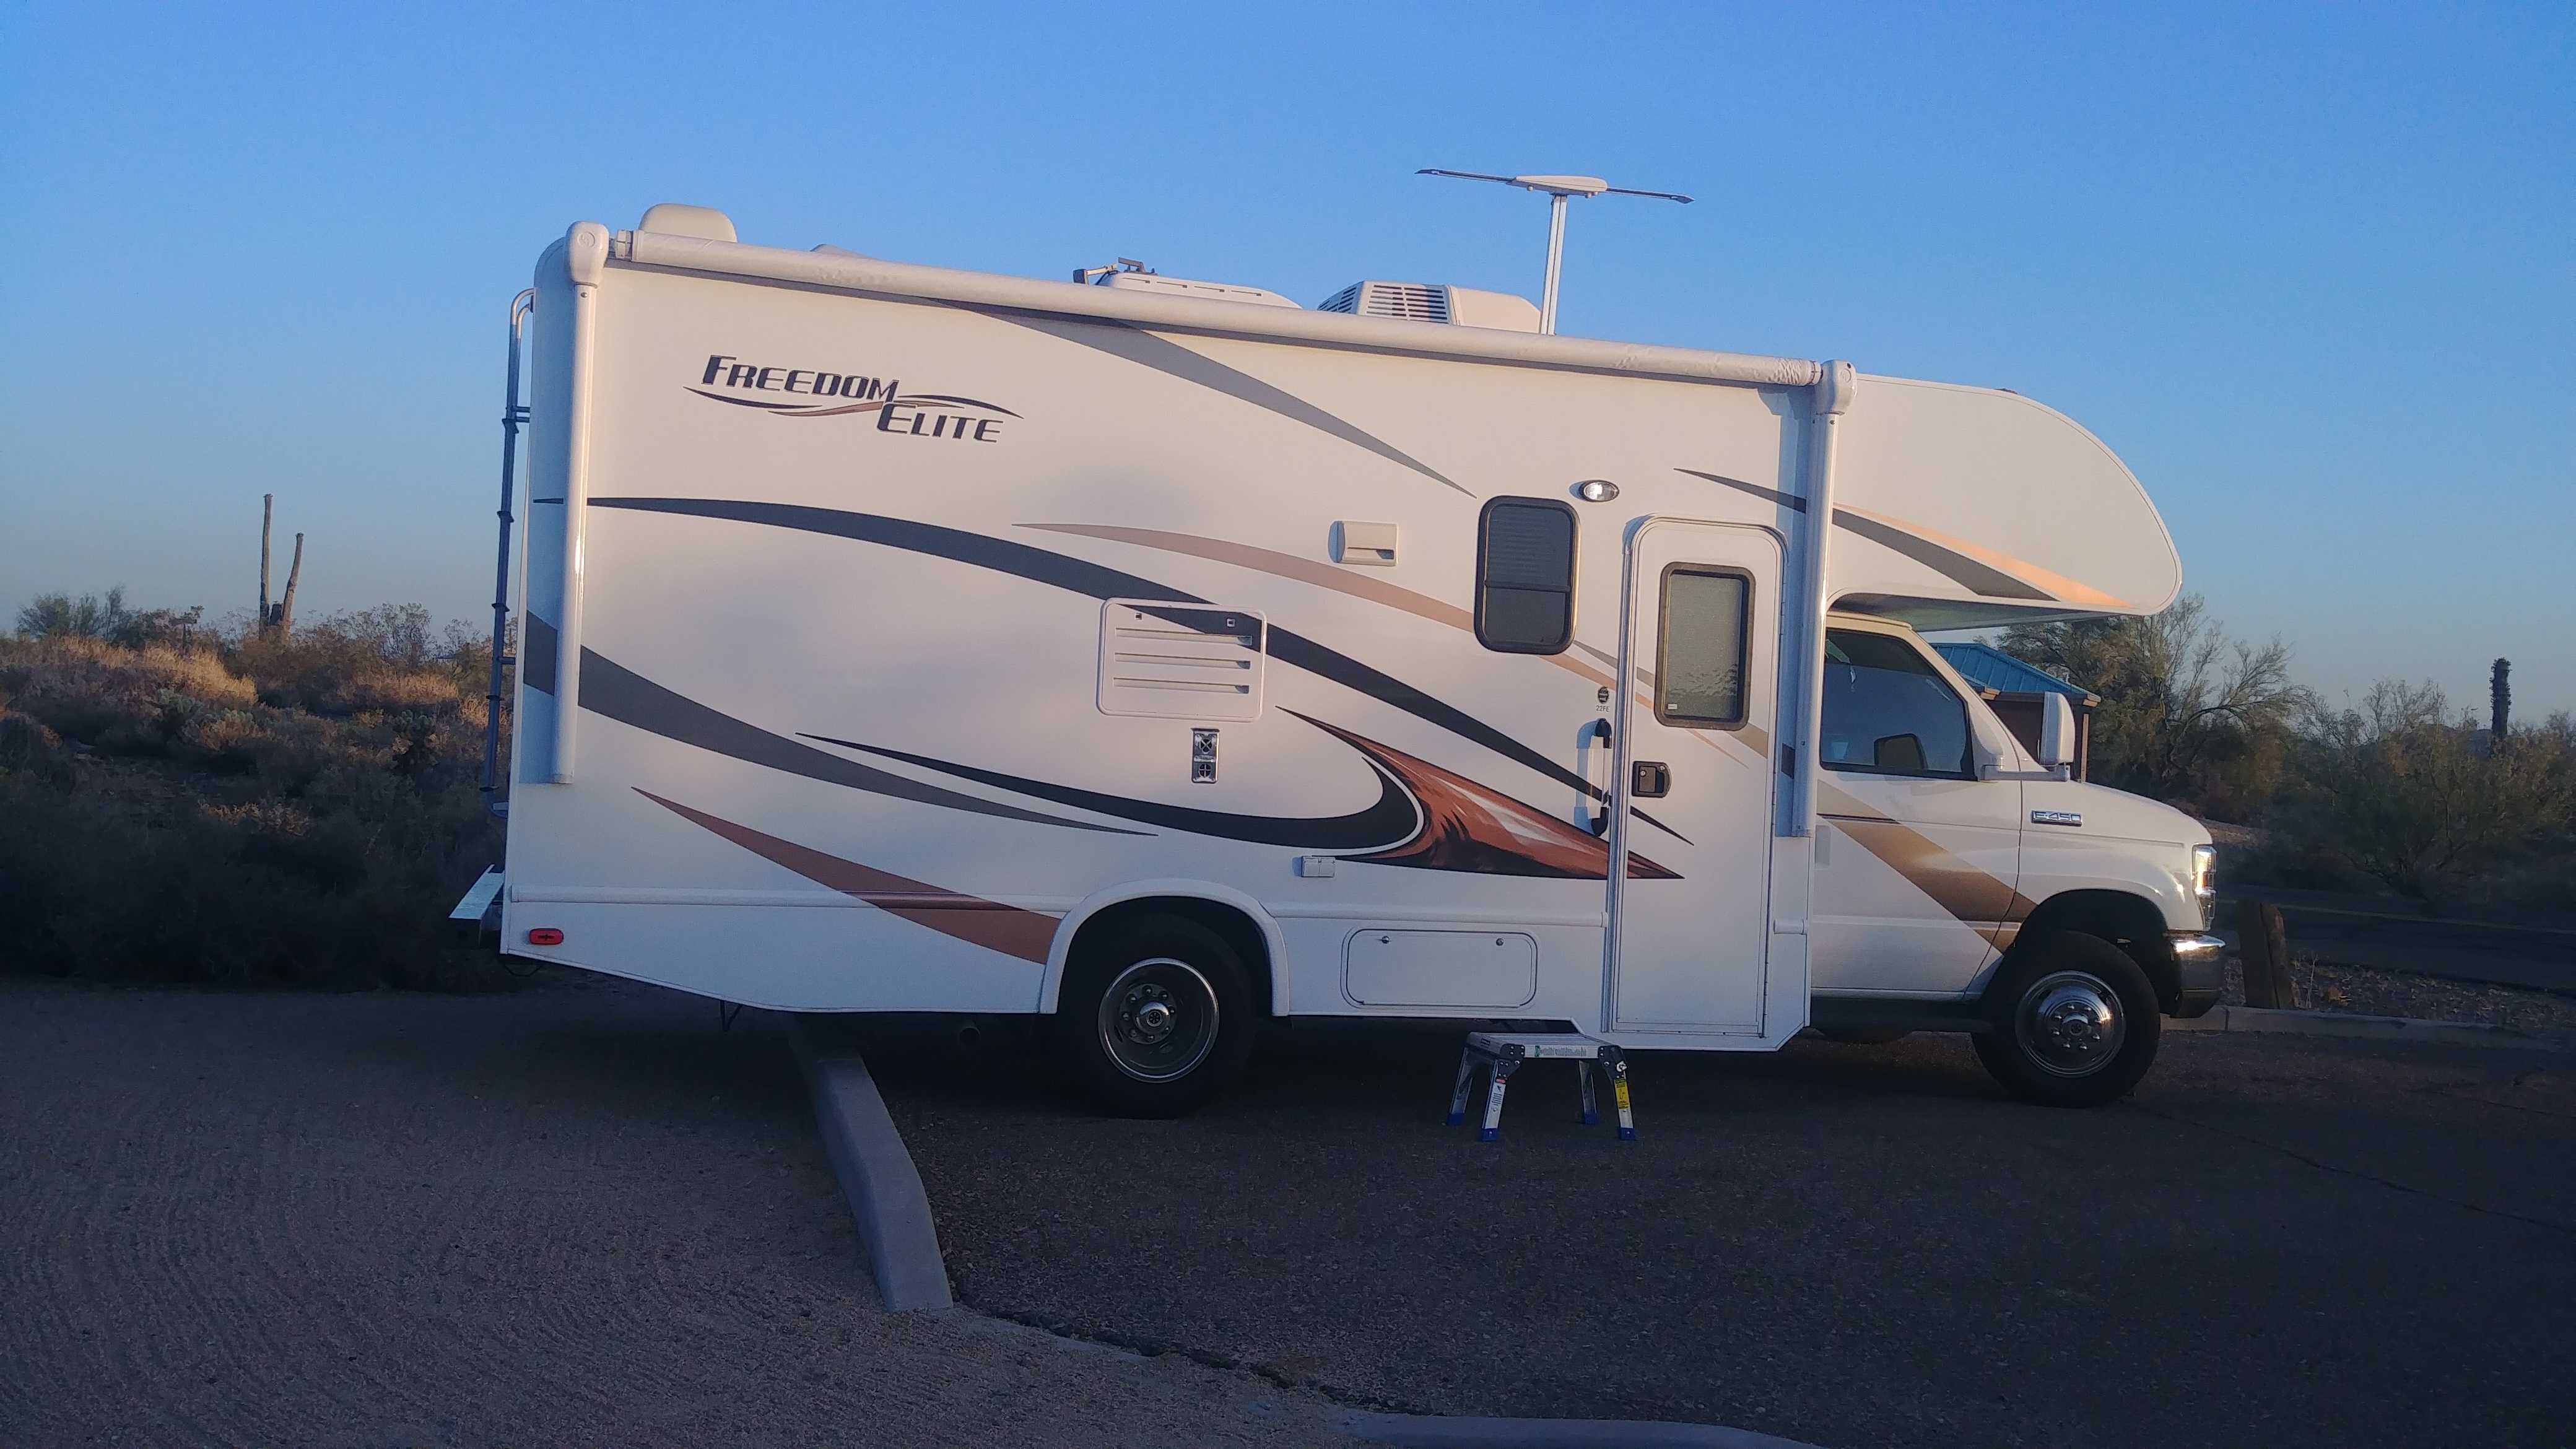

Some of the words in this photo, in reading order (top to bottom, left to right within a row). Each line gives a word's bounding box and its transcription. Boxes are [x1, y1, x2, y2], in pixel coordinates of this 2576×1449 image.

[700, 355, 899, 402] FREEDOM
[876, 402, 1004, 443] ELITE
[2033, 811, 2081, 824] E-450
